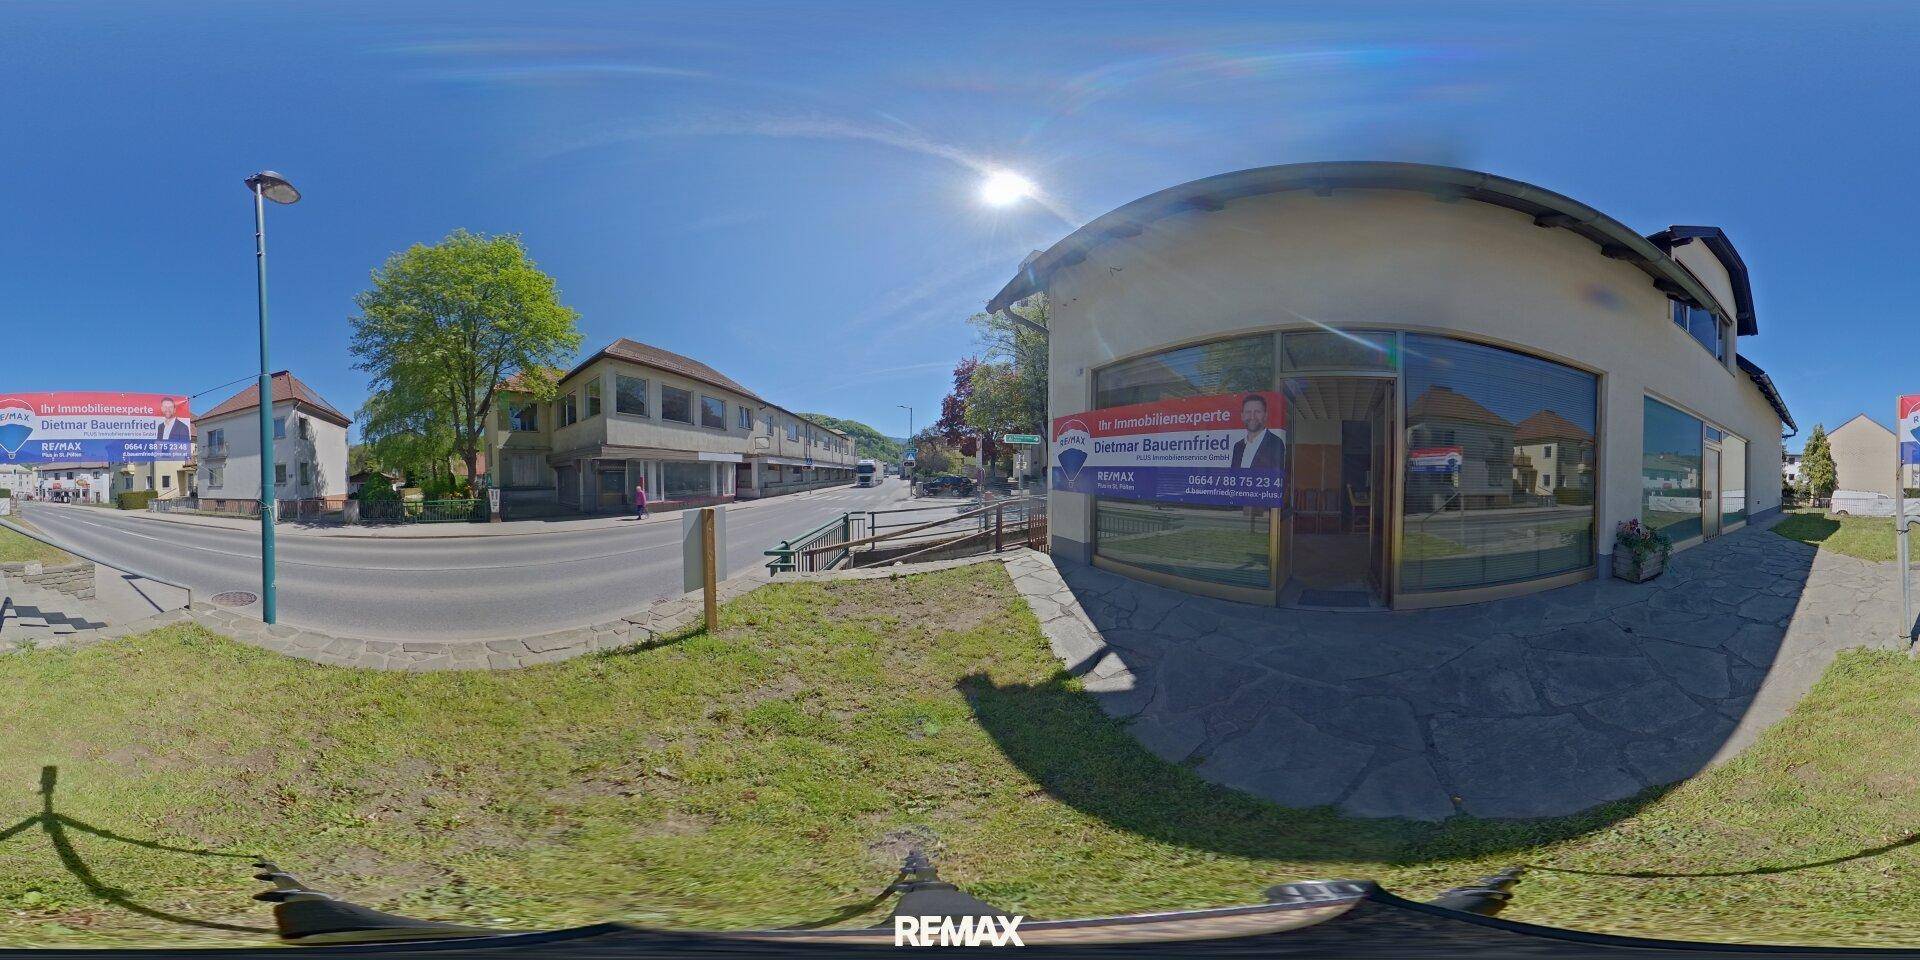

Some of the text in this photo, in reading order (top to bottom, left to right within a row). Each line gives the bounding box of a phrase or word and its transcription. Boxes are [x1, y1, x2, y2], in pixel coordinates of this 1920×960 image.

[41, 404, 154, 415] Ihr Immobilienexperte
[41, 420, 156, 430] Dietmar Bauernfried
[1098, 409, 1230, 431] Ihr Immobilienexperte
[41, 442, 81, 451] RE/MAX
[124, 443, 142, 451] 0664
[1094, 434, 1230, 453] Dietmar Bauernfried
[1152, 453, 1207, 461] Immobilienservice
[1208, 453, 1230, 461] GmbH
[1097, 471, 1134, 481] RE/MAX
[1188, 475, 1213, 485] 0664
[1215, 476, 1221, 486] /
[1223, 476, 1236, 486] 88
[1239, 477, 1253, 487] 75
[1256, 477, 1270, 488] 23
